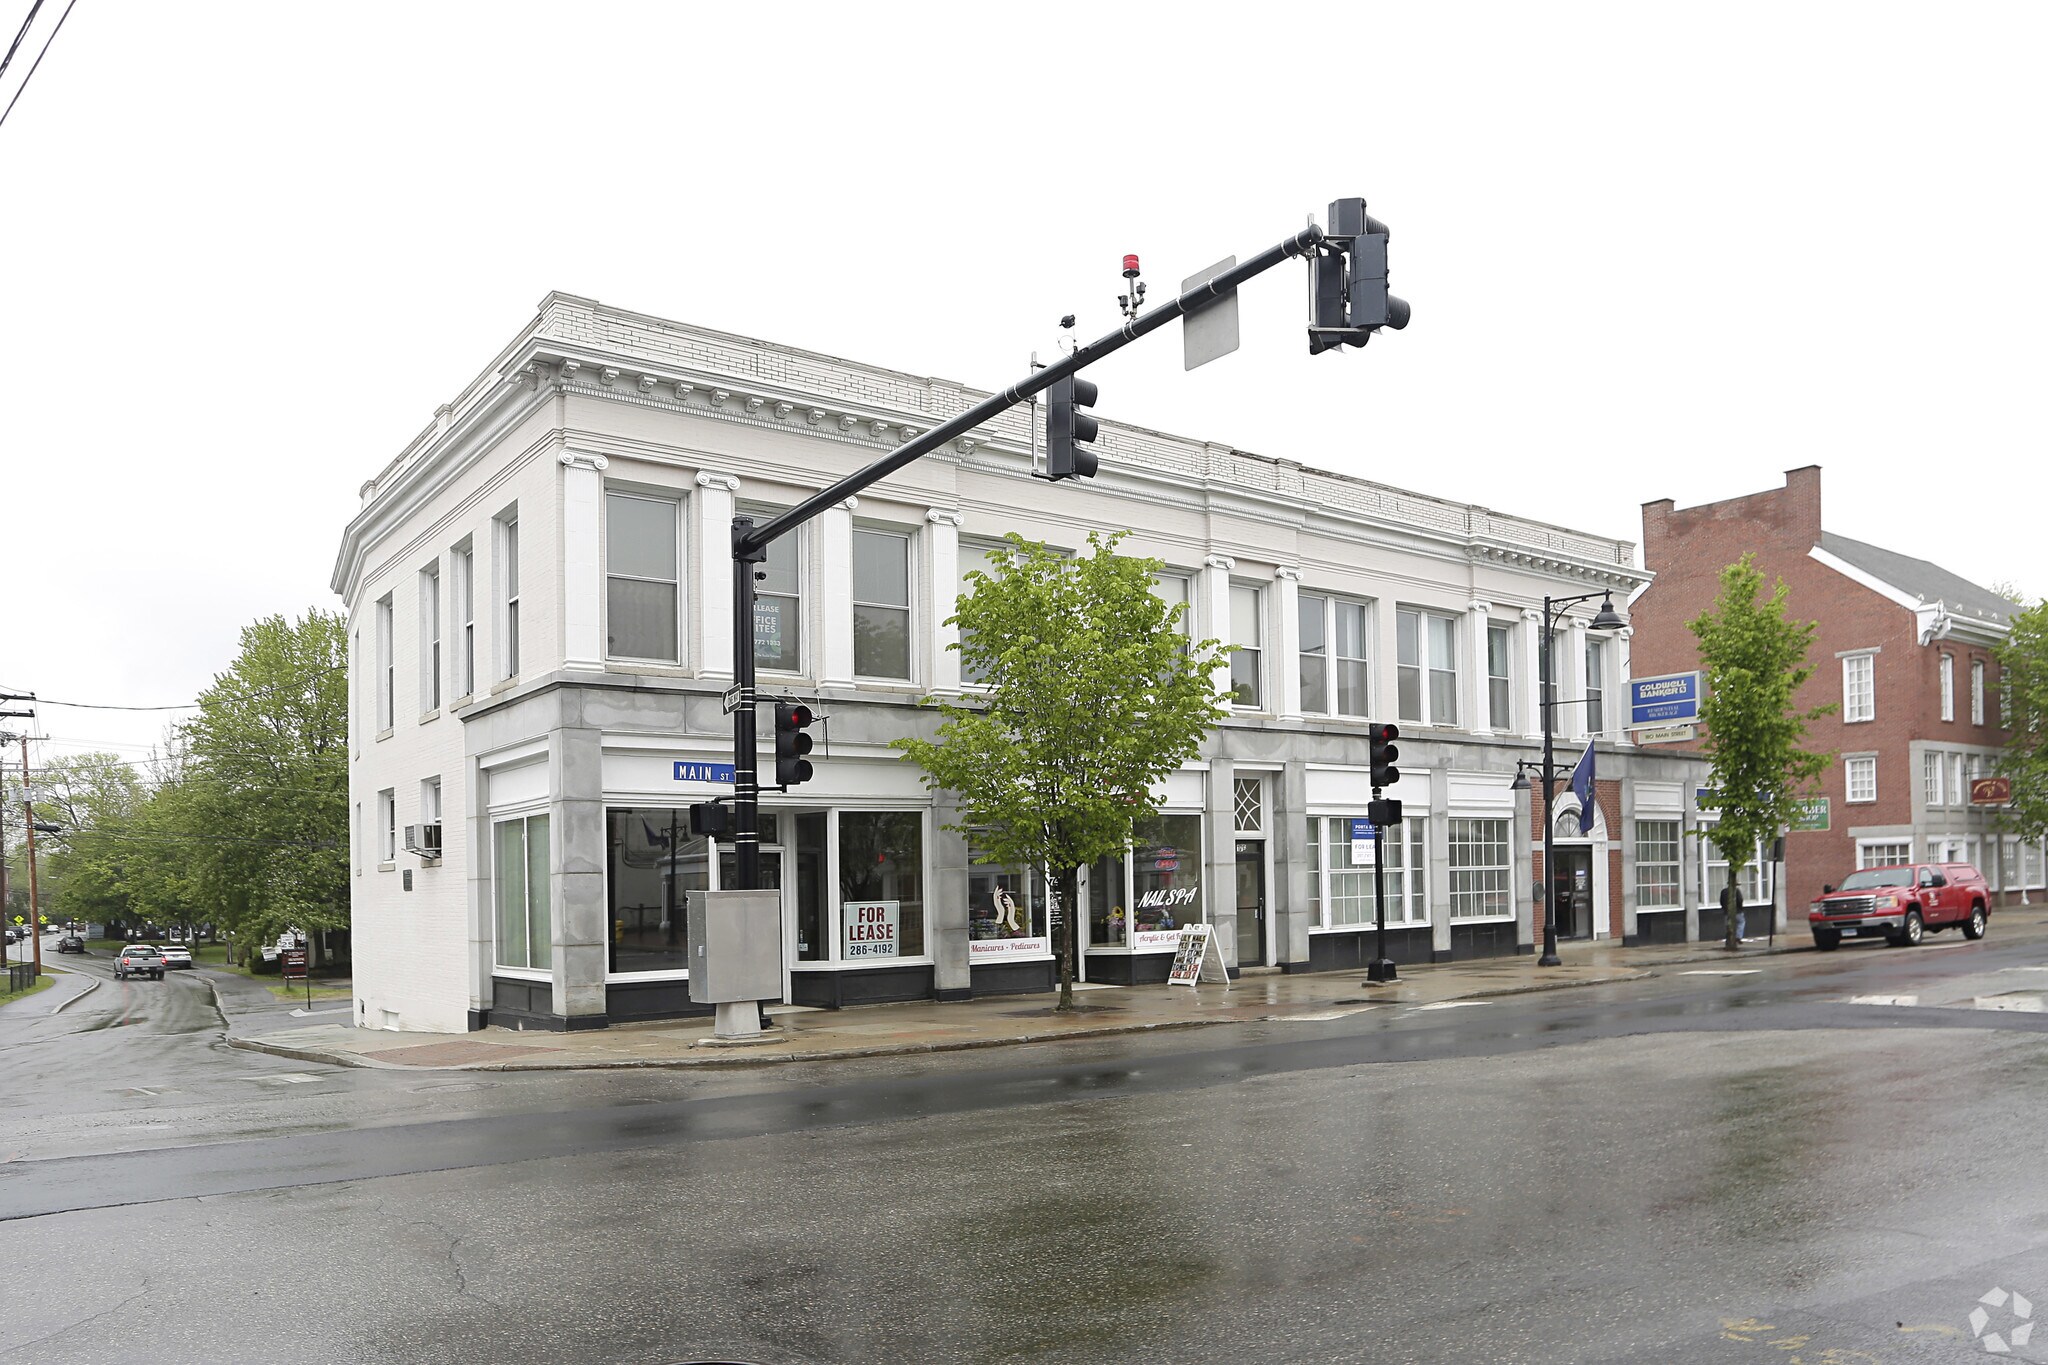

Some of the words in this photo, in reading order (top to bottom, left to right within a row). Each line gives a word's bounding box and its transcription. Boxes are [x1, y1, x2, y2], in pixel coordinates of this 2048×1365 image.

[754, 616, 776, 625] FICE
[755, 624, 776, 634] ITES
[1640, 680, 1686, 691] COLDWELL
[1640, 688, 1678, 698] BANKER
[680, 766, 712, 780] MAIN
[1138, 890, 1166, 908] NAIL
[1165, 887, 1198, 906] SPA
[858, 906, 884, 922] FOR
[849, 924, 893, 941] LEASE
[1140, 934, 1159, 944] Acrylic
[850, 944, 892, 955] 286-4192
[971, 944, 1004, 953] Manicures
[1010, 942, 1040, 950] Pedicures
